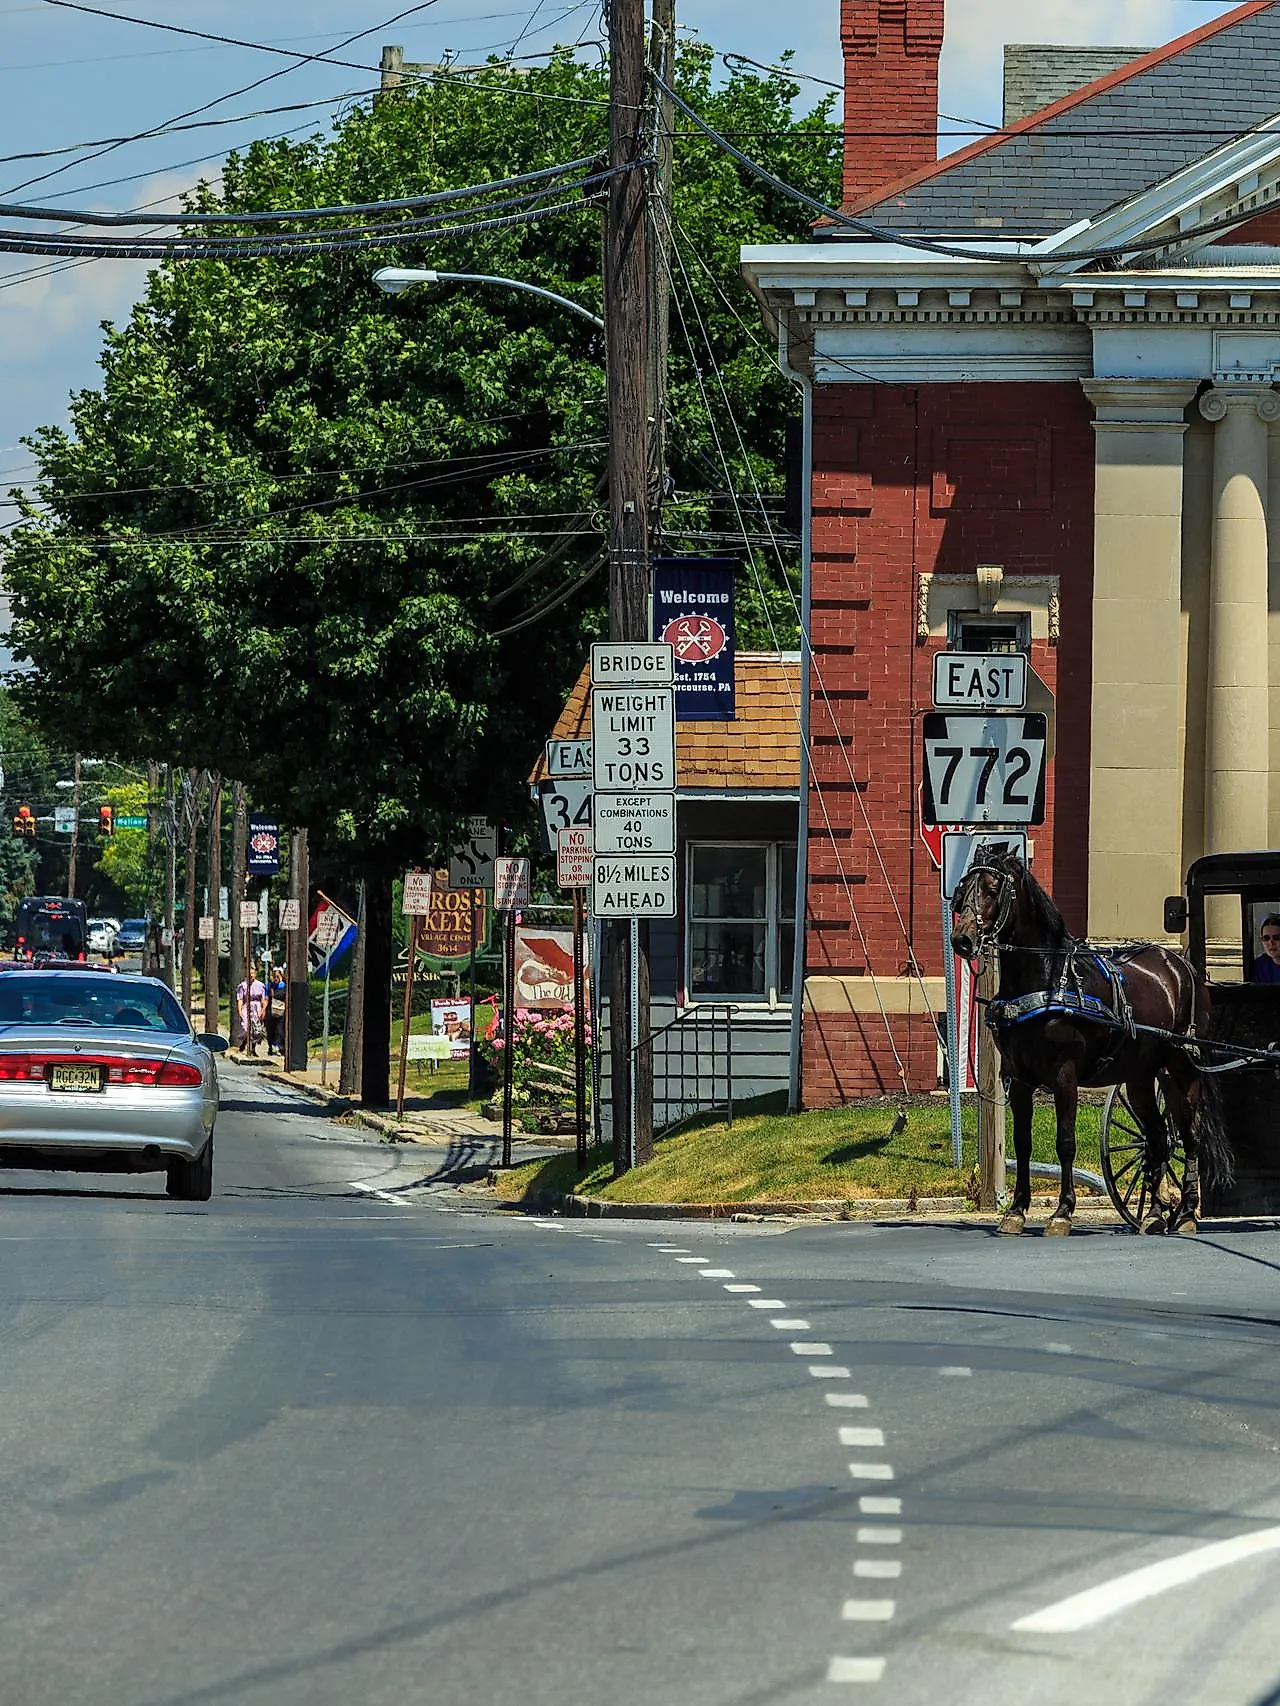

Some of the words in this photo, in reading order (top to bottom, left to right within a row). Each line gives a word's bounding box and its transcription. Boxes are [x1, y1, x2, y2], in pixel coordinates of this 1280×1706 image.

[660, 590, 729, 604] Welcome
[600, 656, 665, 671] BRIDGE
[694, 673, 716, 681] 1754
[948, 663, 1014, 699] EAST
[718, 683, 731, 692] PA
[601, 696, 666, 711] WEIGHT
[610, 716, 656, 732] LIMIT
[617, 738, 650, 756] 33
[605, 763, 663, 782] TONS
[934, 747, 1031, 805] 772
[616, 798, 651, 806] EXCEPT
[600, 809, 668, 818] COMBINATIONS
[623, 821, 642, 832] 40
[569, 834, 584, 845] NO
[616, 837, 652, 848] TONS
[561, 846, 592, 854] PARKING
[506, 864, 519, 873] NO
[625, 865, 669, 881] MILES
[413, 878, 423, 886] NO
[460, 877, 485, 885] ONLY
[604, 893, 665, 907] AHEAD
[423, 911, 472, 932] KEYS
[421, 934, 446, 942] VILLAGE
[533, 984, 551, 999] The
[554, 984, 571, 1000] Old
